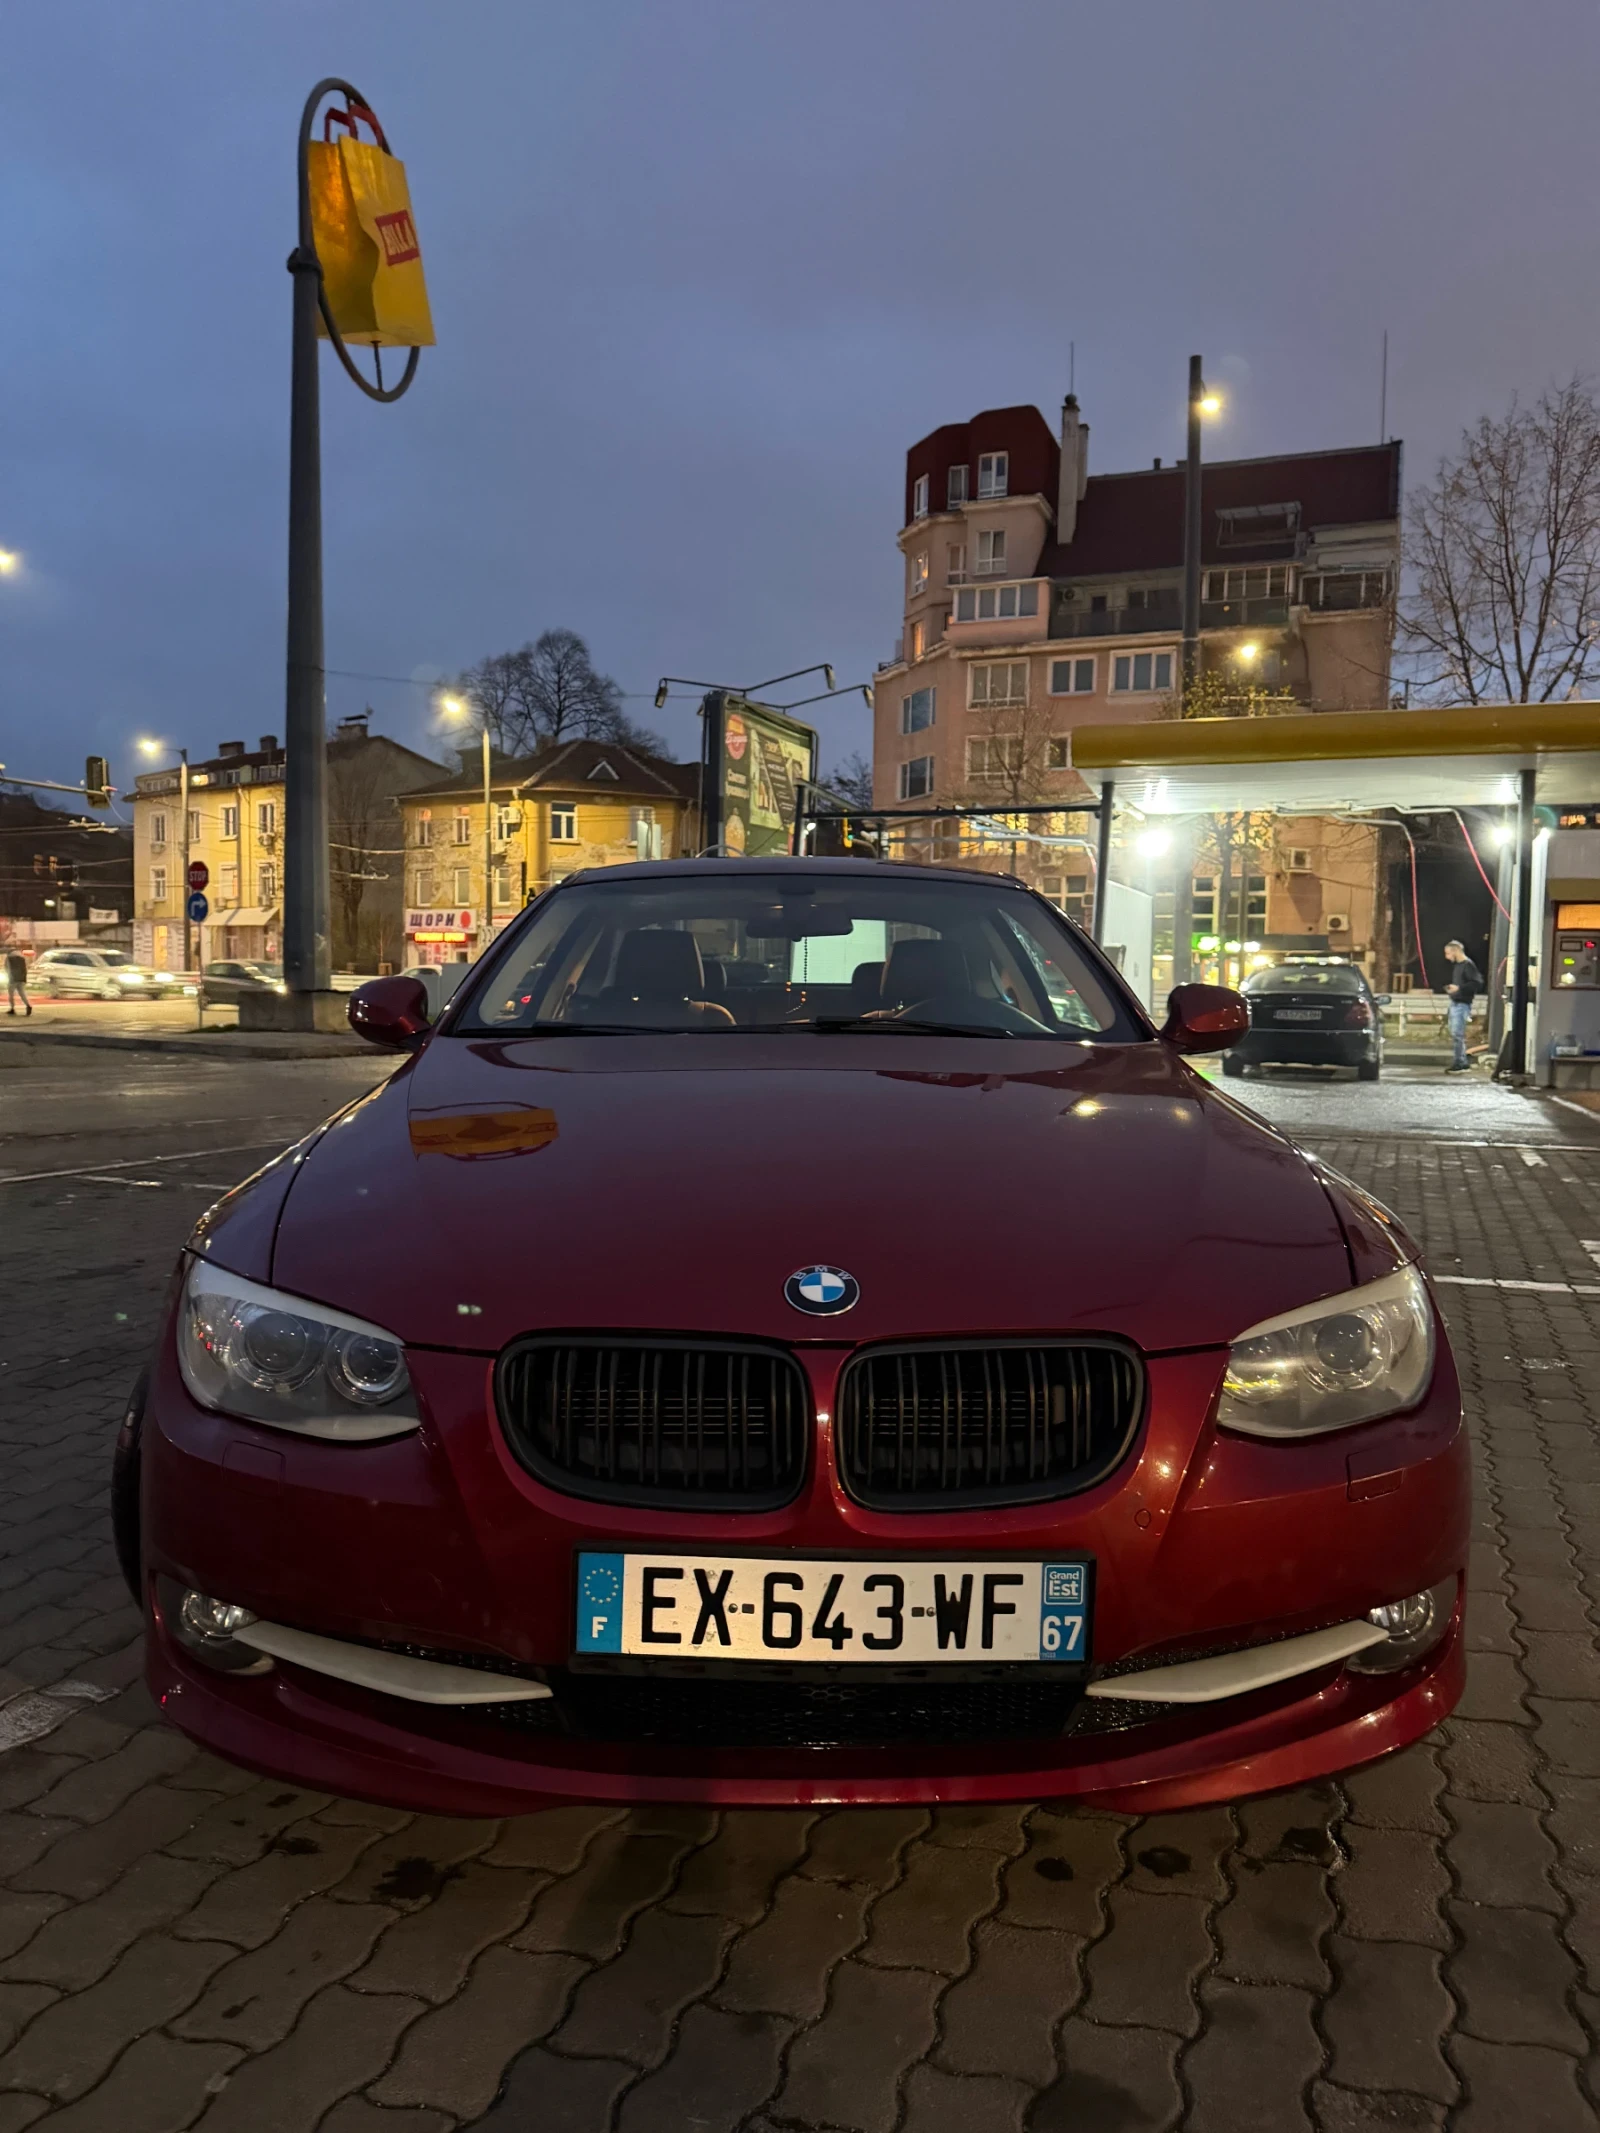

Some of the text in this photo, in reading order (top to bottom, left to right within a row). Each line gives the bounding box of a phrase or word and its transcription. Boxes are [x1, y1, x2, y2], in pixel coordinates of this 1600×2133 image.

[381, 219, 417, 256] BILLA
[189, 870, 206, 882] STOP
[410, 913, 456, 927] ЩОРИ
[792, 1265, 852, 1280] BMW
[1049, 1571, 1079, 1580] Grand
[1049, 1580, 1079, 1596] Est
[641, 1566, 1024, 1650] EX-643-WF
[592, 1616, 608, 1638] F
[1042, 1615, 1083, 1651] 67
